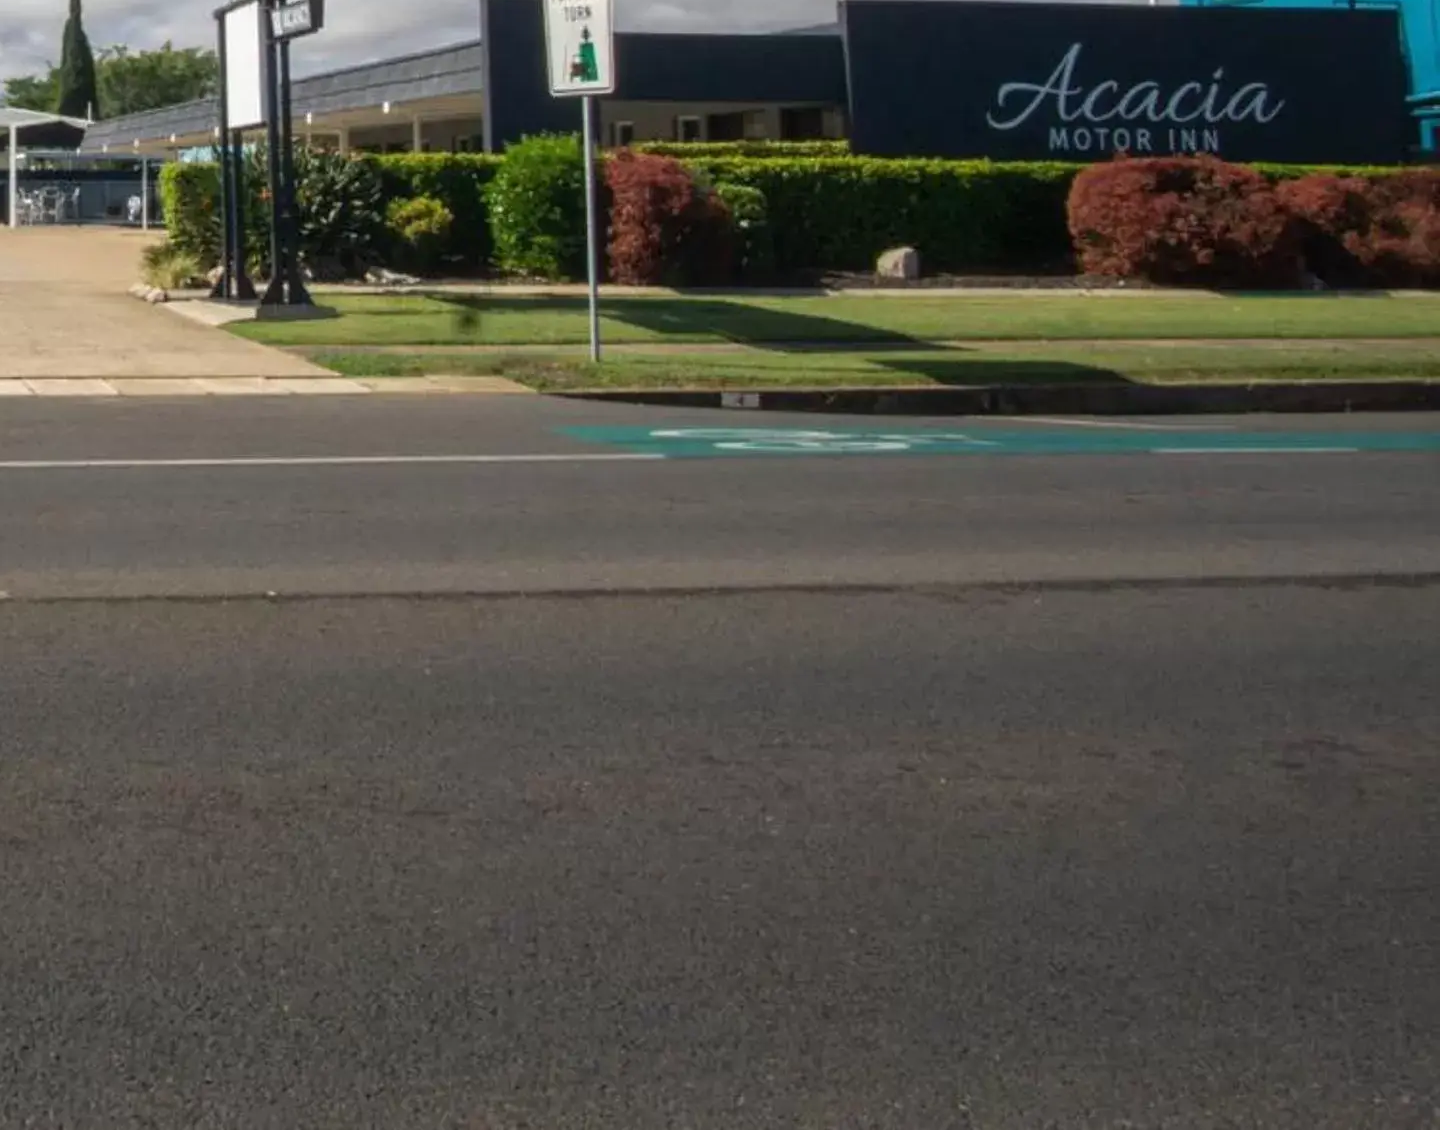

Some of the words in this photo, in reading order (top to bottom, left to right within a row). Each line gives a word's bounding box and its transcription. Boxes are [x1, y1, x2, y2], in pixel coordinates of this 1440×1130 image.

[564, 5, 592, 22] TURN
[986, 43, 1284, 130] Acacia
[1049, 128, 1152, 151] MOTOR
[1169, 129, 1219, 152] INN
